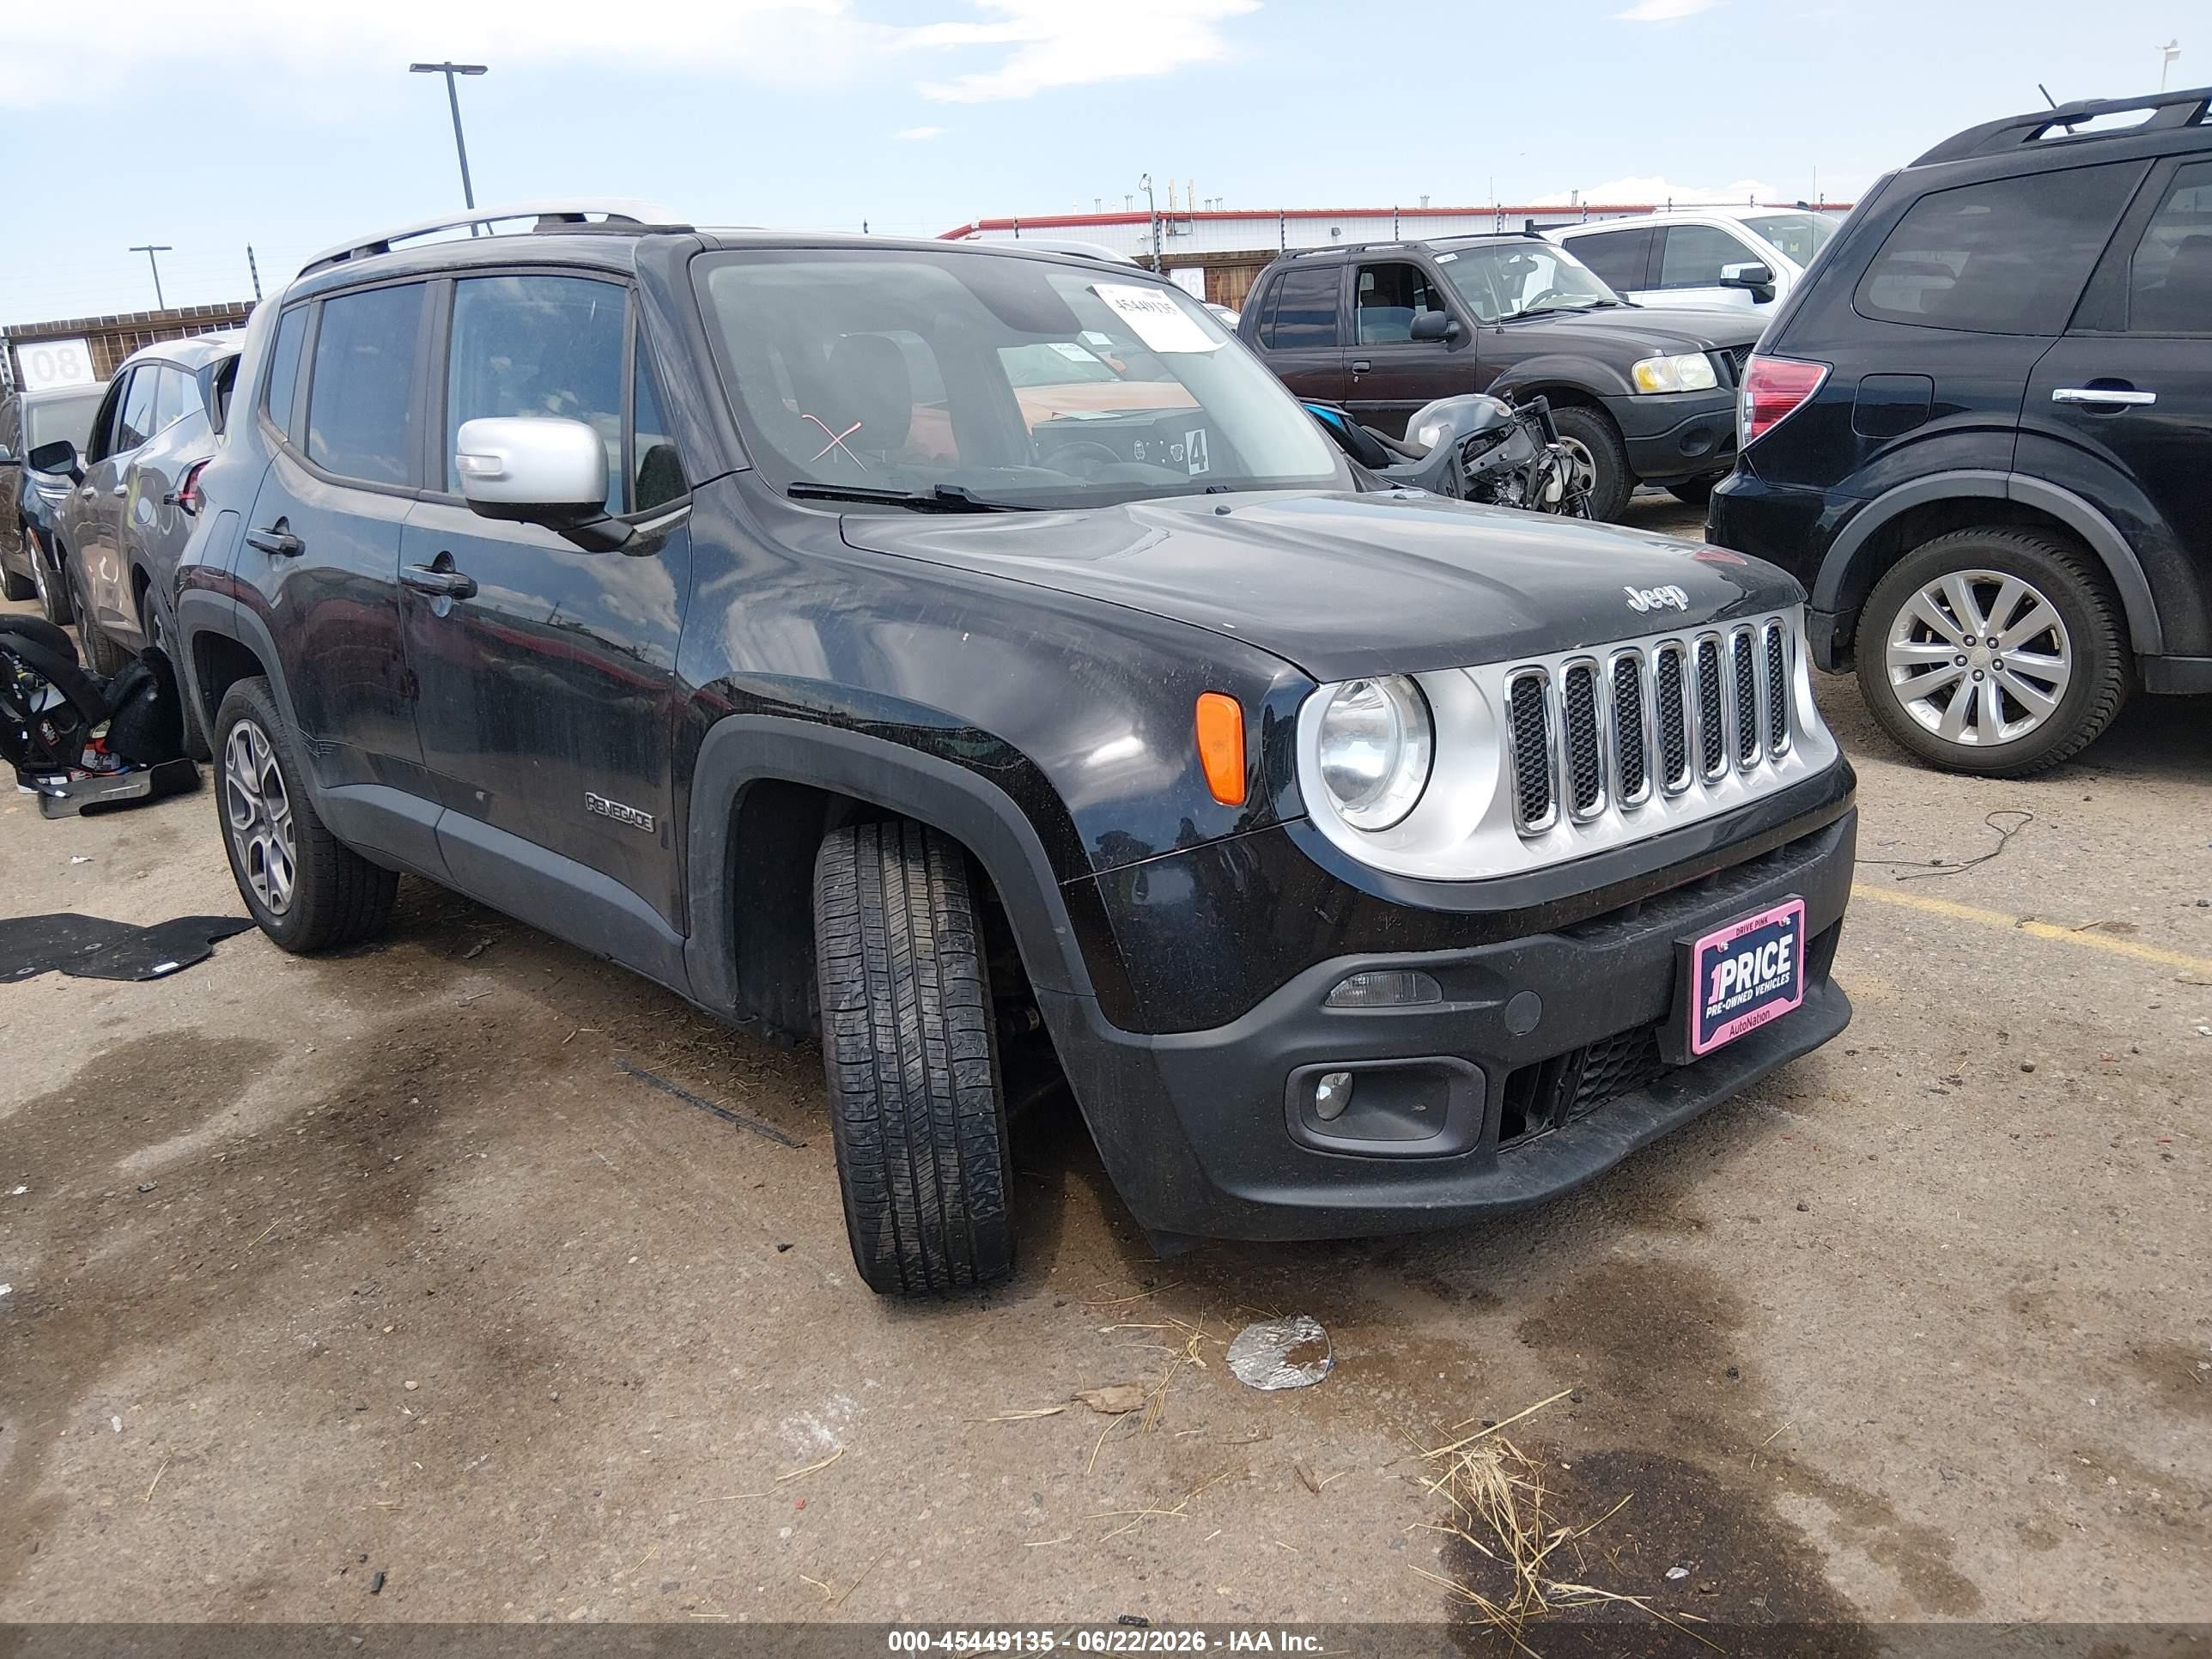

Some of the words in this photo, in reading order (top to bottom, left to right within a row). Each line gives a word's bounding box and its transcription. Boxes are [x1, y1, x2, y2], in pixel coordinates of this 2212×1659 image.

[33, 348, 82, 382] 08
[1189, 431, 1206, 471] 4
[1623, 585, 1689, 611] Jeep
[585, 792, 655, 833] RENEGADE
[1735, 922, 1753, 936] DRIVE
[1754, 915, 1769, 929] PINK
[1705, 988, 1753, 1019] PRE-OWNED
[1755, 972, 1790, 997] VEHICLES
[1729, 1009, 1771, 1037] AutoNation
